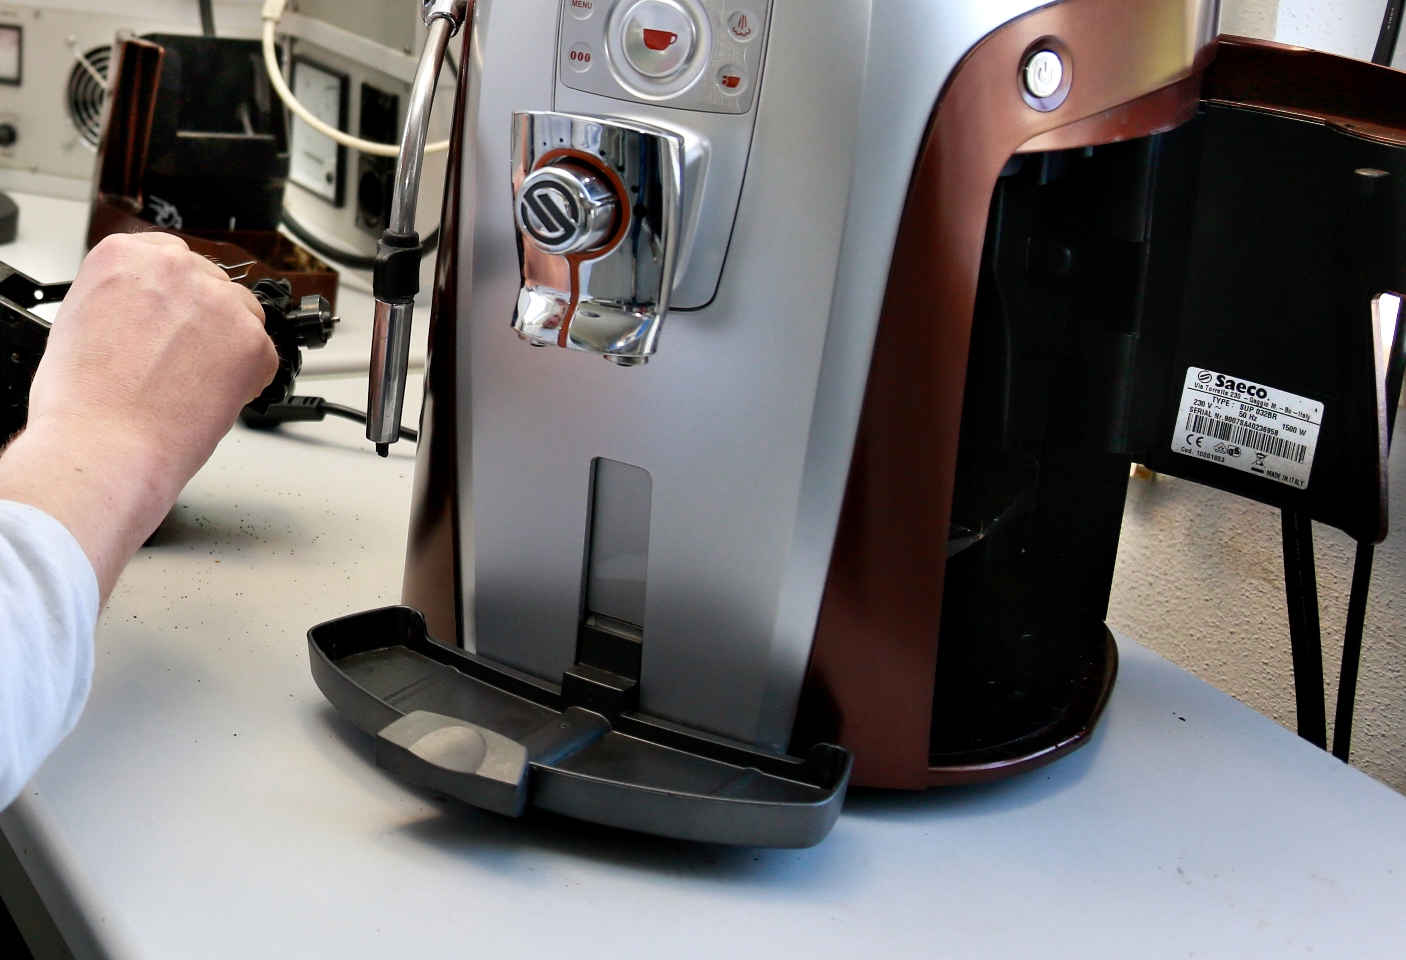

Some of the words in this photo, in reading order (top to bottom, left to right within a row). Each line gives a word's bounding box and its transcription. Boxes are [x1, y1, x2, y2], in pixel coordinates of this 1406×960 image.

[571, 0, 593, 9] MENU
[1214, 374, 1268, 400] Saeco
[1189, 406, 1212, 418] SERIAL
[1193, 398, 1206, 408] 230
[1238, 410, 1248, 420] 50
[1249, 413, 1257, 422] Hz
[1281, 423, 1297, 434] 1500
[1299, 428, 1307, 436] W
[1239, 404, 1254, 415] SUP
[1266, 469, 1281, 480] MADE
[1282, 474, 1288, 482] IN
[1289, 476, 1305, 487] ITALY
